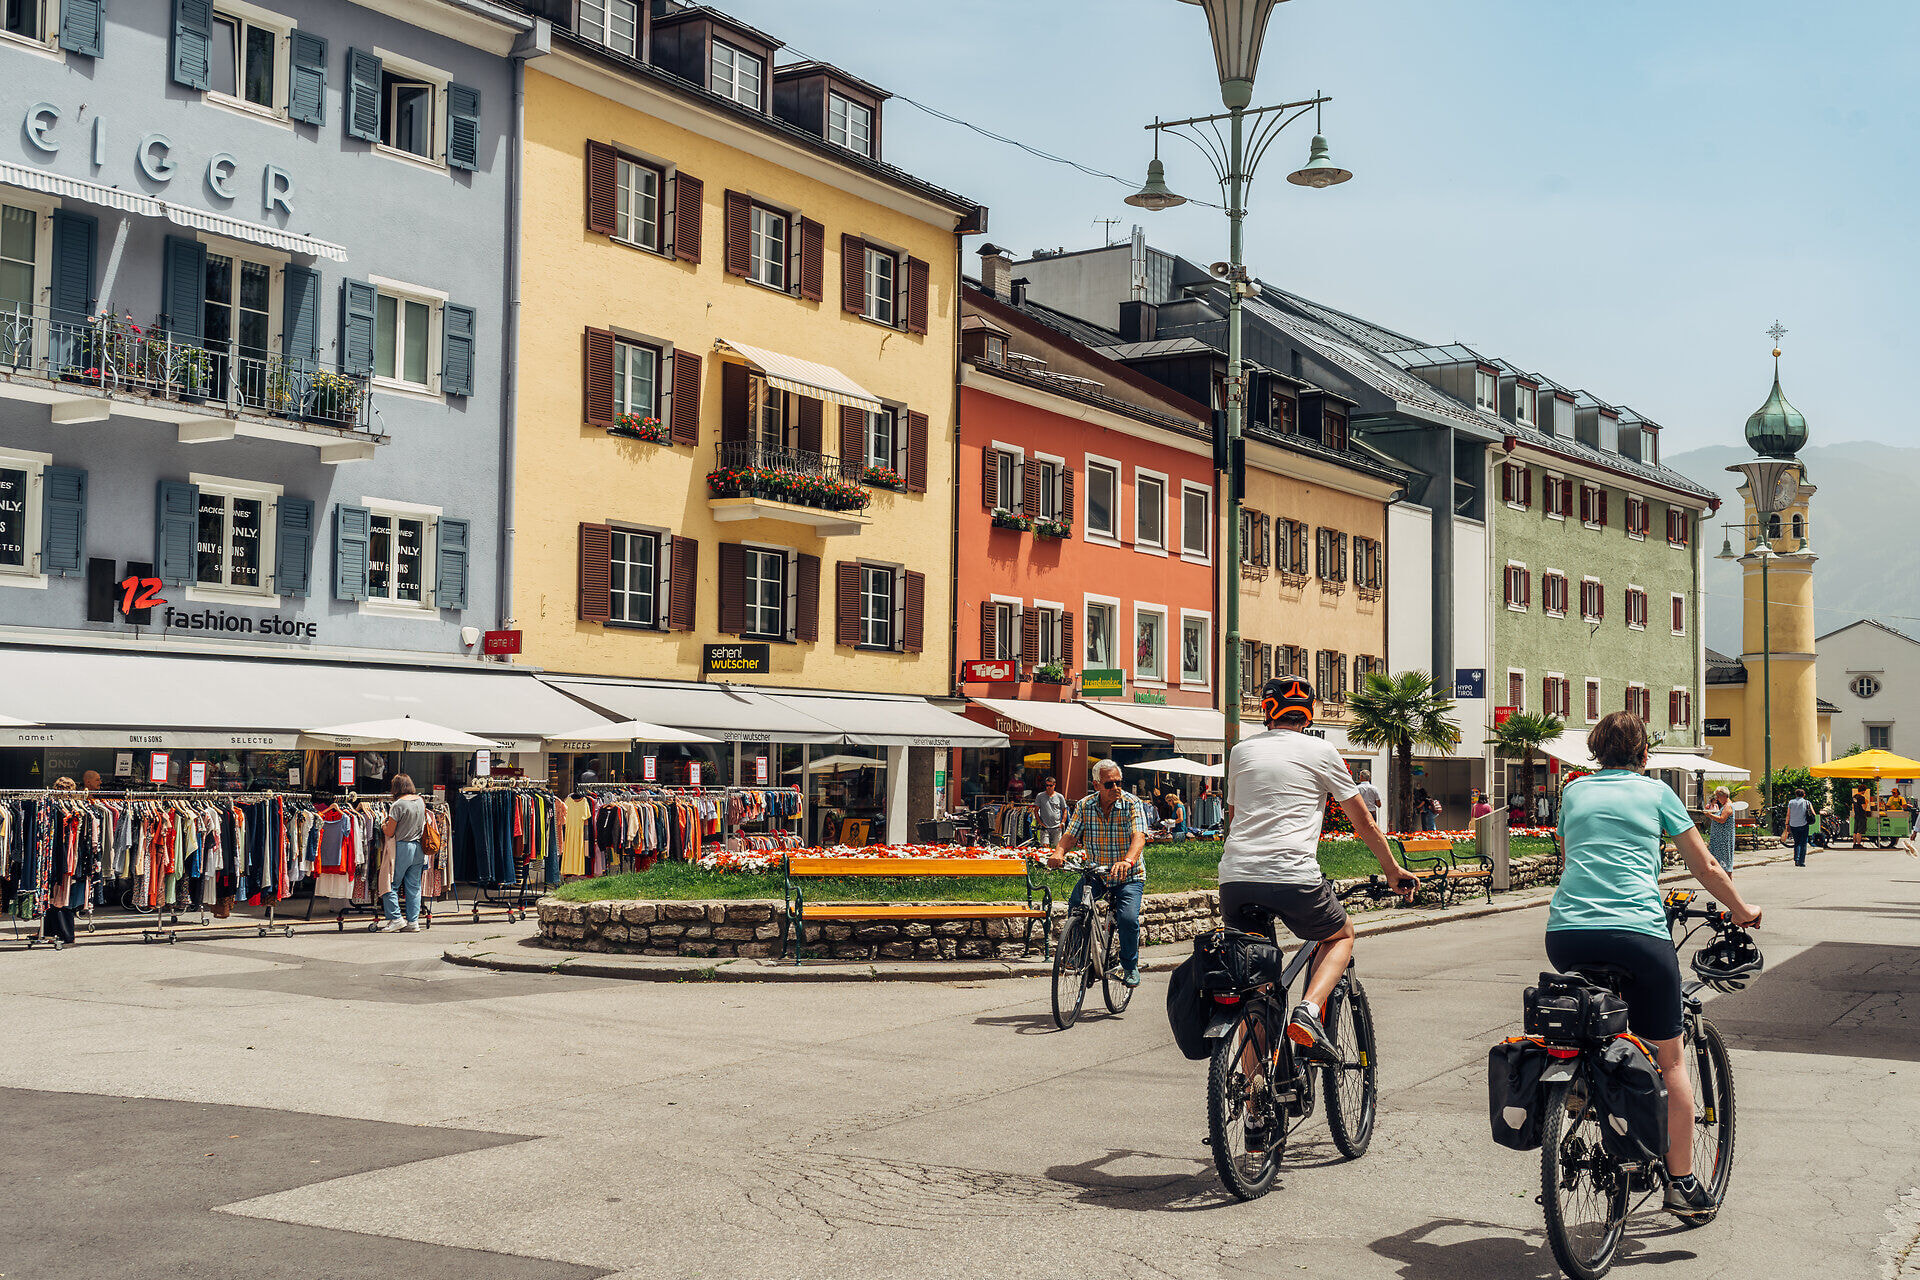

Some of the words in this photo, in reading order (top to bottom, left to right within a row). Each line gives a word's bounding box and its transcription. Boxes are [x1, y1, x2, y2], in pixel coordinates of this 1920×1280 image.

[197, 541, 217, 554] ONLY
[165, 606, 253, 634] fashion
[259, 614, 317, 638] store
[711, 646, 742, 658] sehen!
[711, 658, 760, 669] wutscher
[972, 663, 1010, 679] Tirol
[995, 718, 1014, 732] Tirol
[129, 735, 143, 743] ONLY
[563, 741, 592, 750] PIECES
